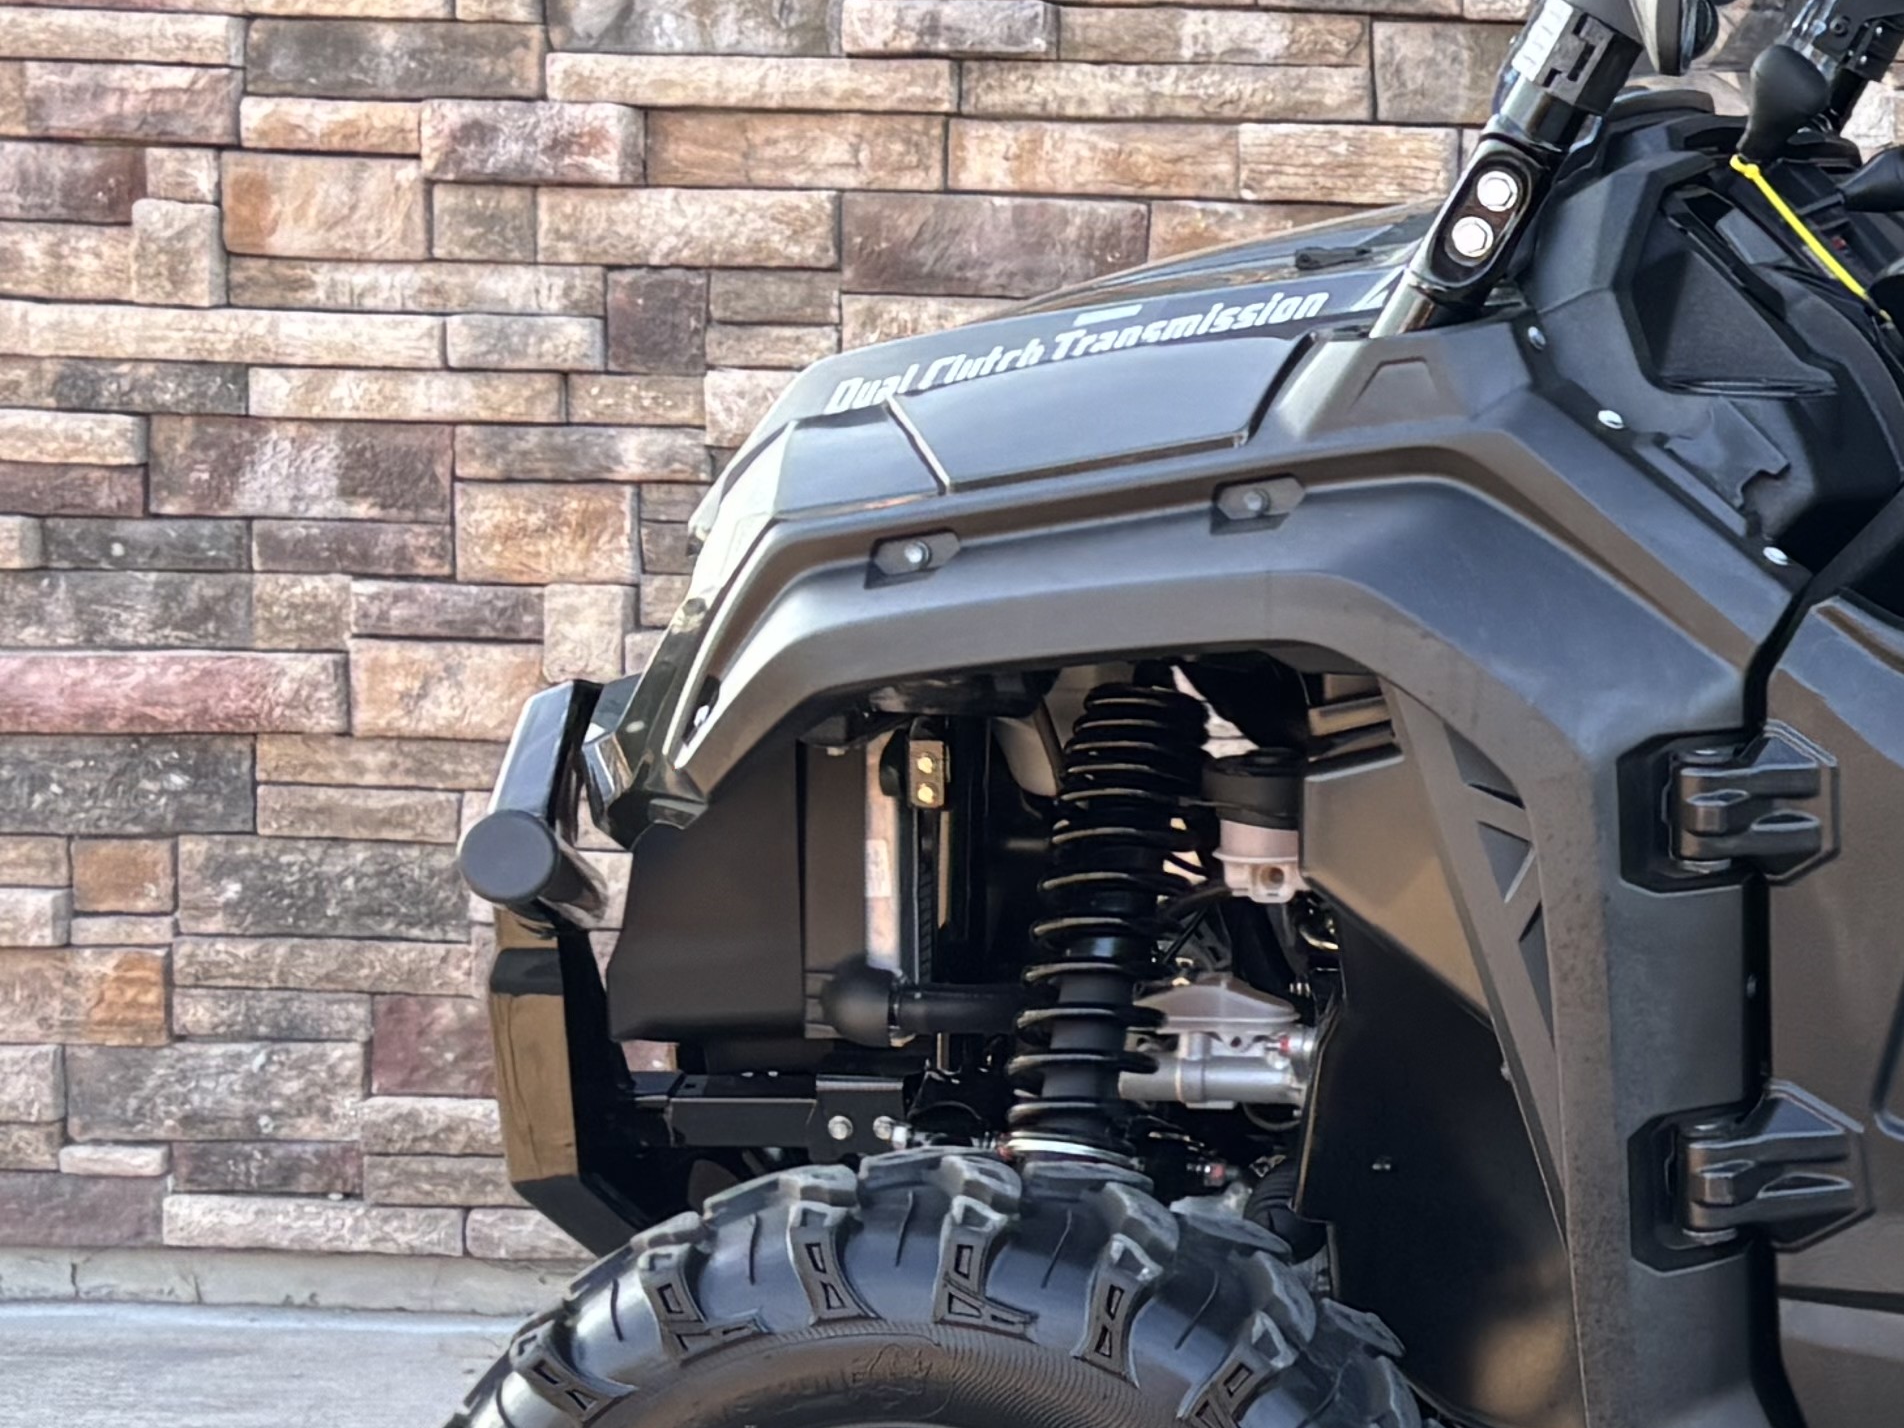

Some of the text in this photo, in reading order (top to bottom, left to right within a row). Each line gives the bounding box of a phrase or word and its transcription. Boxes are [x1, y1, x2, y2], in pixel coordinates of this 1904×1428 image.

[824, 292, 1330, 415] Dual Clutch Transmission
